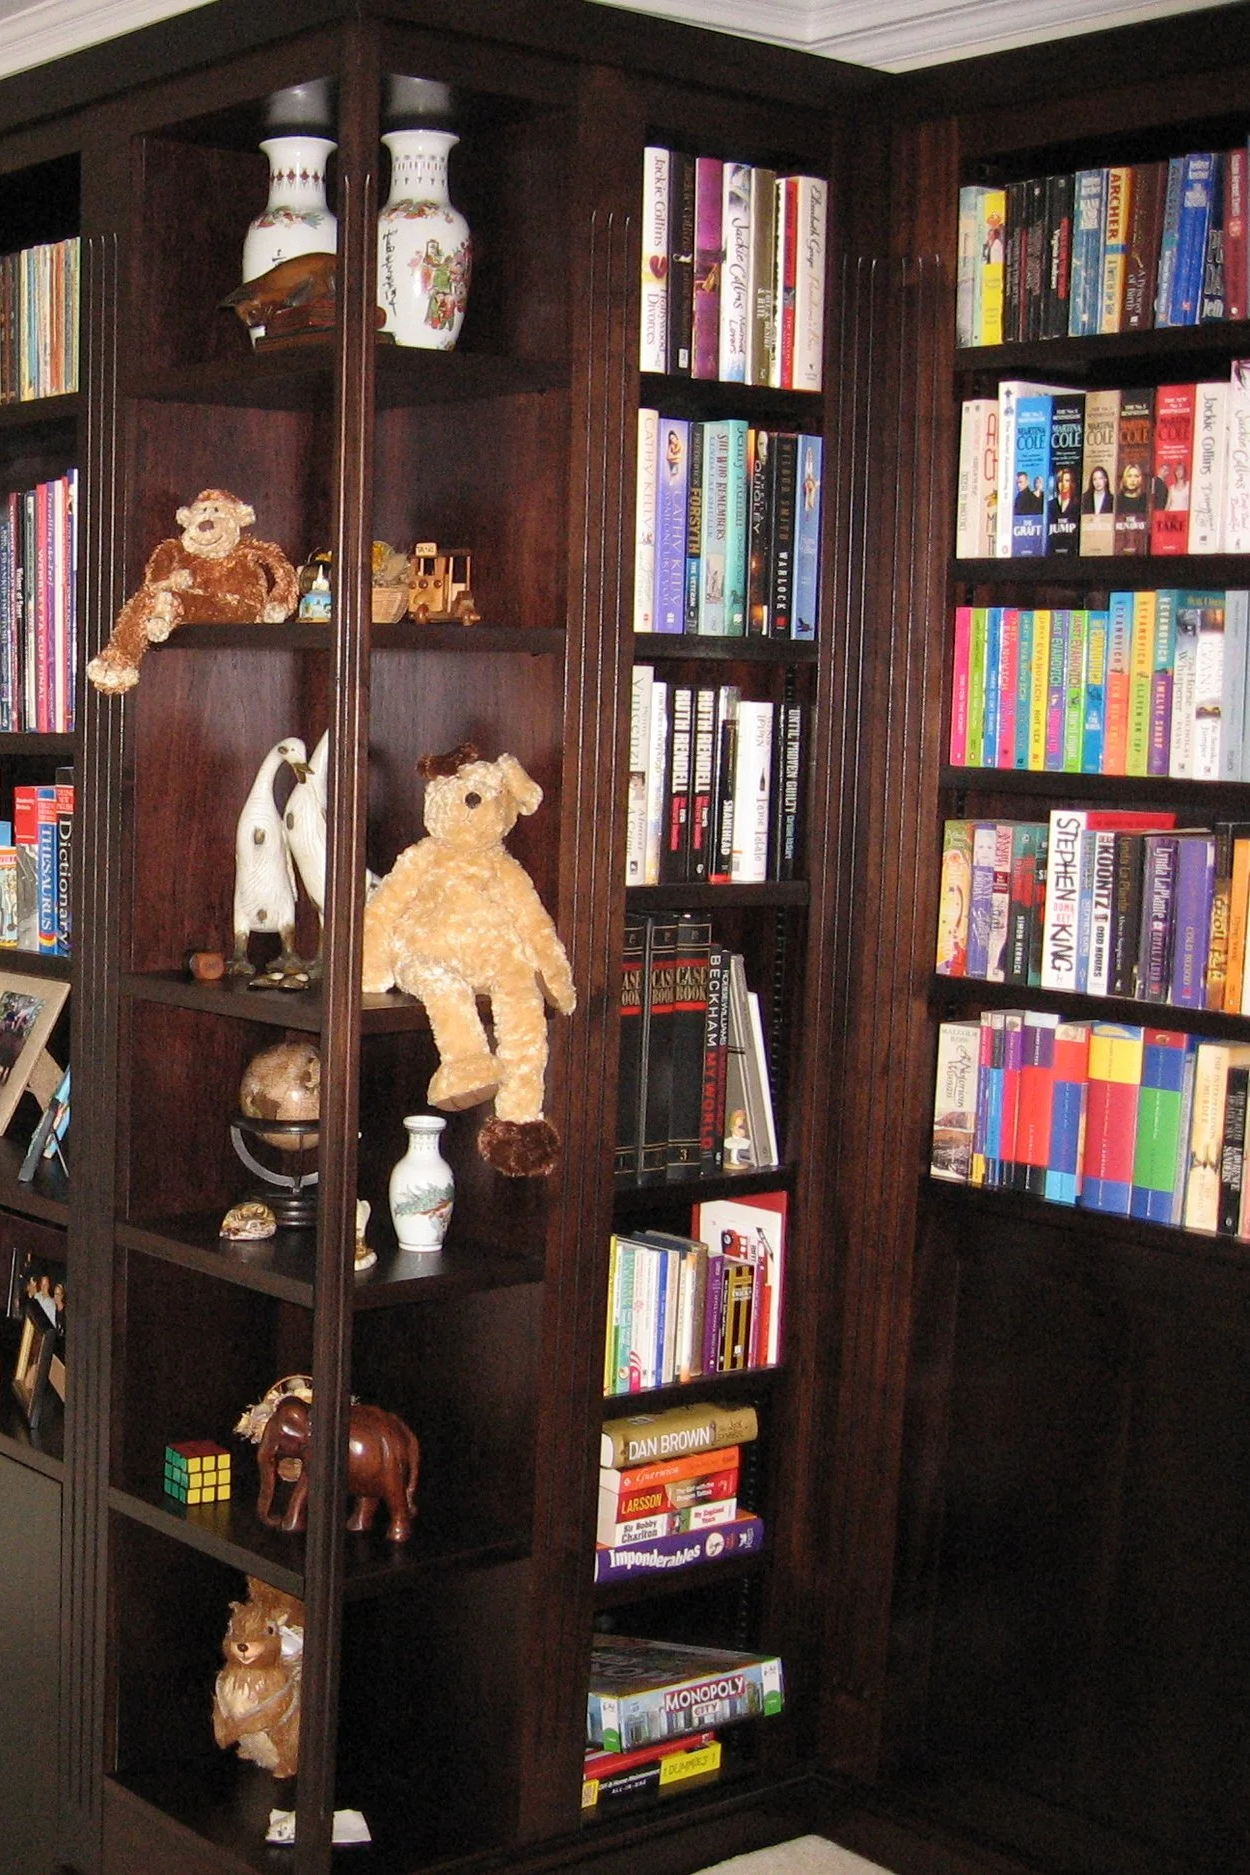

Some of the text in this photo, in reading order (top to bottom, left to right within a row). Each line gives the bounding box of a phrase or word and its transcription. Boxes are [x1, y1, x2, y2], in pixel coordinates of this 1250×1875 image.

[653, 157, 668, 247] Jackie Collins
[1108, 173, 1122, 240] ARCHER
[729, 217, 749, 310] Jackie Collins
[646, 293, 659, 346] Divorces
[1016, 434, 1046, 451] COLE
[1051, 431, 1082, 449] COLE
[1087, 429, 1114, 446] COLE
[1199, 394, 1218, 476] Jackie Collins
[1233, 450, 1250, 490] Collins
[690, 487, 702, 555] FORSYTH
[715, 482, 728, 542] REMEMBERS
[1013, 525, 1043, 537] GRAFT
[1049, 523, 1077, 536] JUMP
[1157, 521, 1184, 533] TAKE
[670, 490, 683, 608] CATHY KELLY
[689, 577, 697, 607] VETERAN
[776, 551, 788, 610] WARLOCK
[37, 548, 46, 702] WEMBLEY FA CUP FINAL
[1050, 612, 1065, 688] JANET EVANOVICH
[1069, 613, 1083, 689] JANET EVANOVICH
[1136, 607, 1148, 665] EVANOVICH
[1157, 605, 1171, 663] EVANOVICH
[1002, 625, 1011, 691] EVANOVICH
[1033, 642, 1045, 703] EVANOVICH
[1173, 650, 1188, 712] Whisperer
[673, 689, 692, 731] RUTH
[697, 690, 715, 731] RUTH
[1153, 681, 1166, 749] TWELVE SHARP
[1186, 674, 1197, 706] Horse
[630, 677, 646, 768] Vincenzi
[672, 732, 691, 794] RENDELL
[694, 732, 713, 794] RENDELL
[784, 709, 801, 814] UNTIL PROVEN GUILTY
[720, 799, 734, 856] SNAKEHEAD
[41, 824, 52, 931] THESAURUS
[59, 819, 73, 947] Dictionary
[1054, 818, 1081, 902] STEPHEN
[1095, 844, 1113, 910] KOONTZ
[1152, 847, 1173, 918] Lynda LaPlante
[1015, 915, 1026, 940] SIMON
[1050, 923, 1075, 972] KING
[1093, 926, 1105, 977] ODD HOURS
[676, 966, 707, 986] CASE
[676, 985, 707, 1001] BOOK
[700, 954, 722, 1149] BECKHAM MY WORLD
[680, 1149, 688, 1160] 3
[628, 1425, 711, 1460] DAN BROWN
[621, 1493, 663, 1515] LARSSON
[623, 1519, 658, 1534] Sir Bobby
[608, 1543, 702, 1570] Imponderables
[621, 1528, 659, 1543] Charlton
[665, 1676, 745, 1712] MONOPOLY
[694, 1702, 719, 1716] CITY
[667, 1752, 708, 1777] DUMMIES
